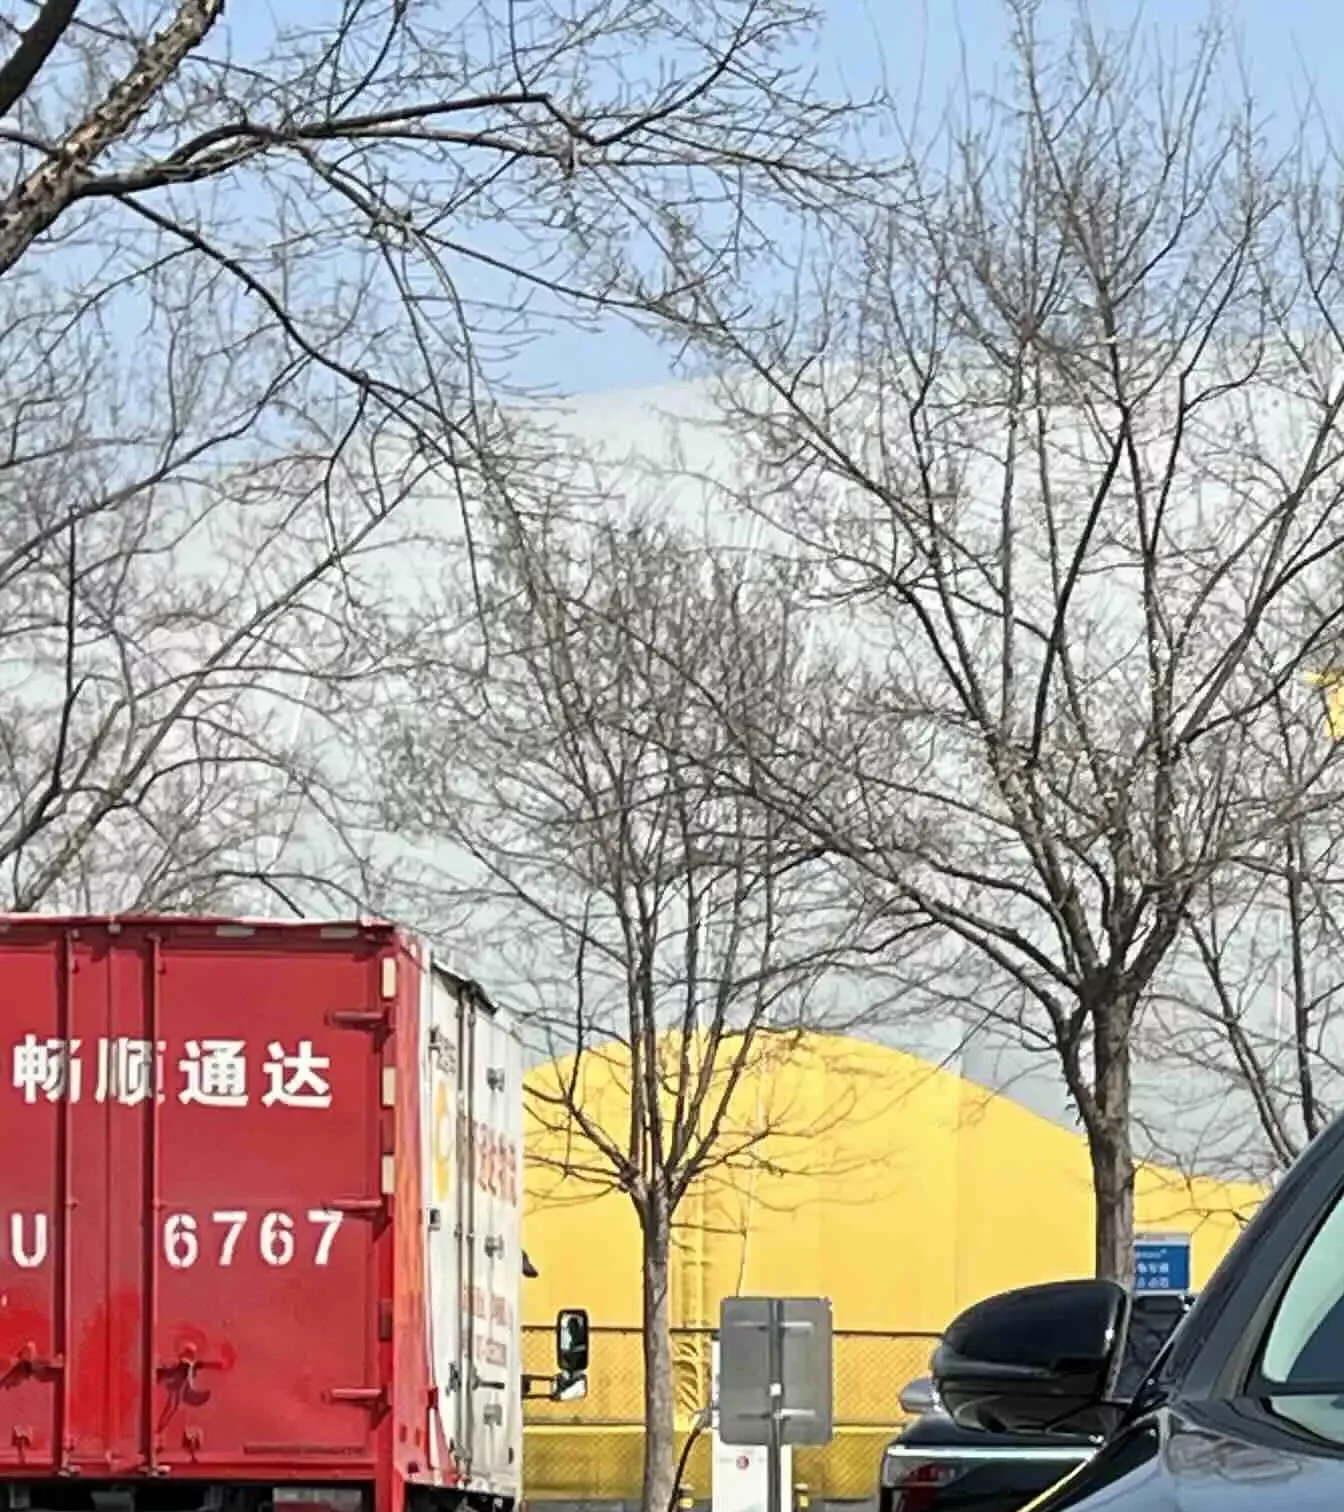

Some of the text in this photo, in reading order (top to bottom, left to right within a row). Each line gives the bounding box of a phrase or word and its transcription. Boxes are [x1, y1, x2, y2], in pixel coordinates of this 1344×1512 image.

[13, 1034, 332, 1108] 畅顺通达
[164, 1211, 343, 1268] 6767
